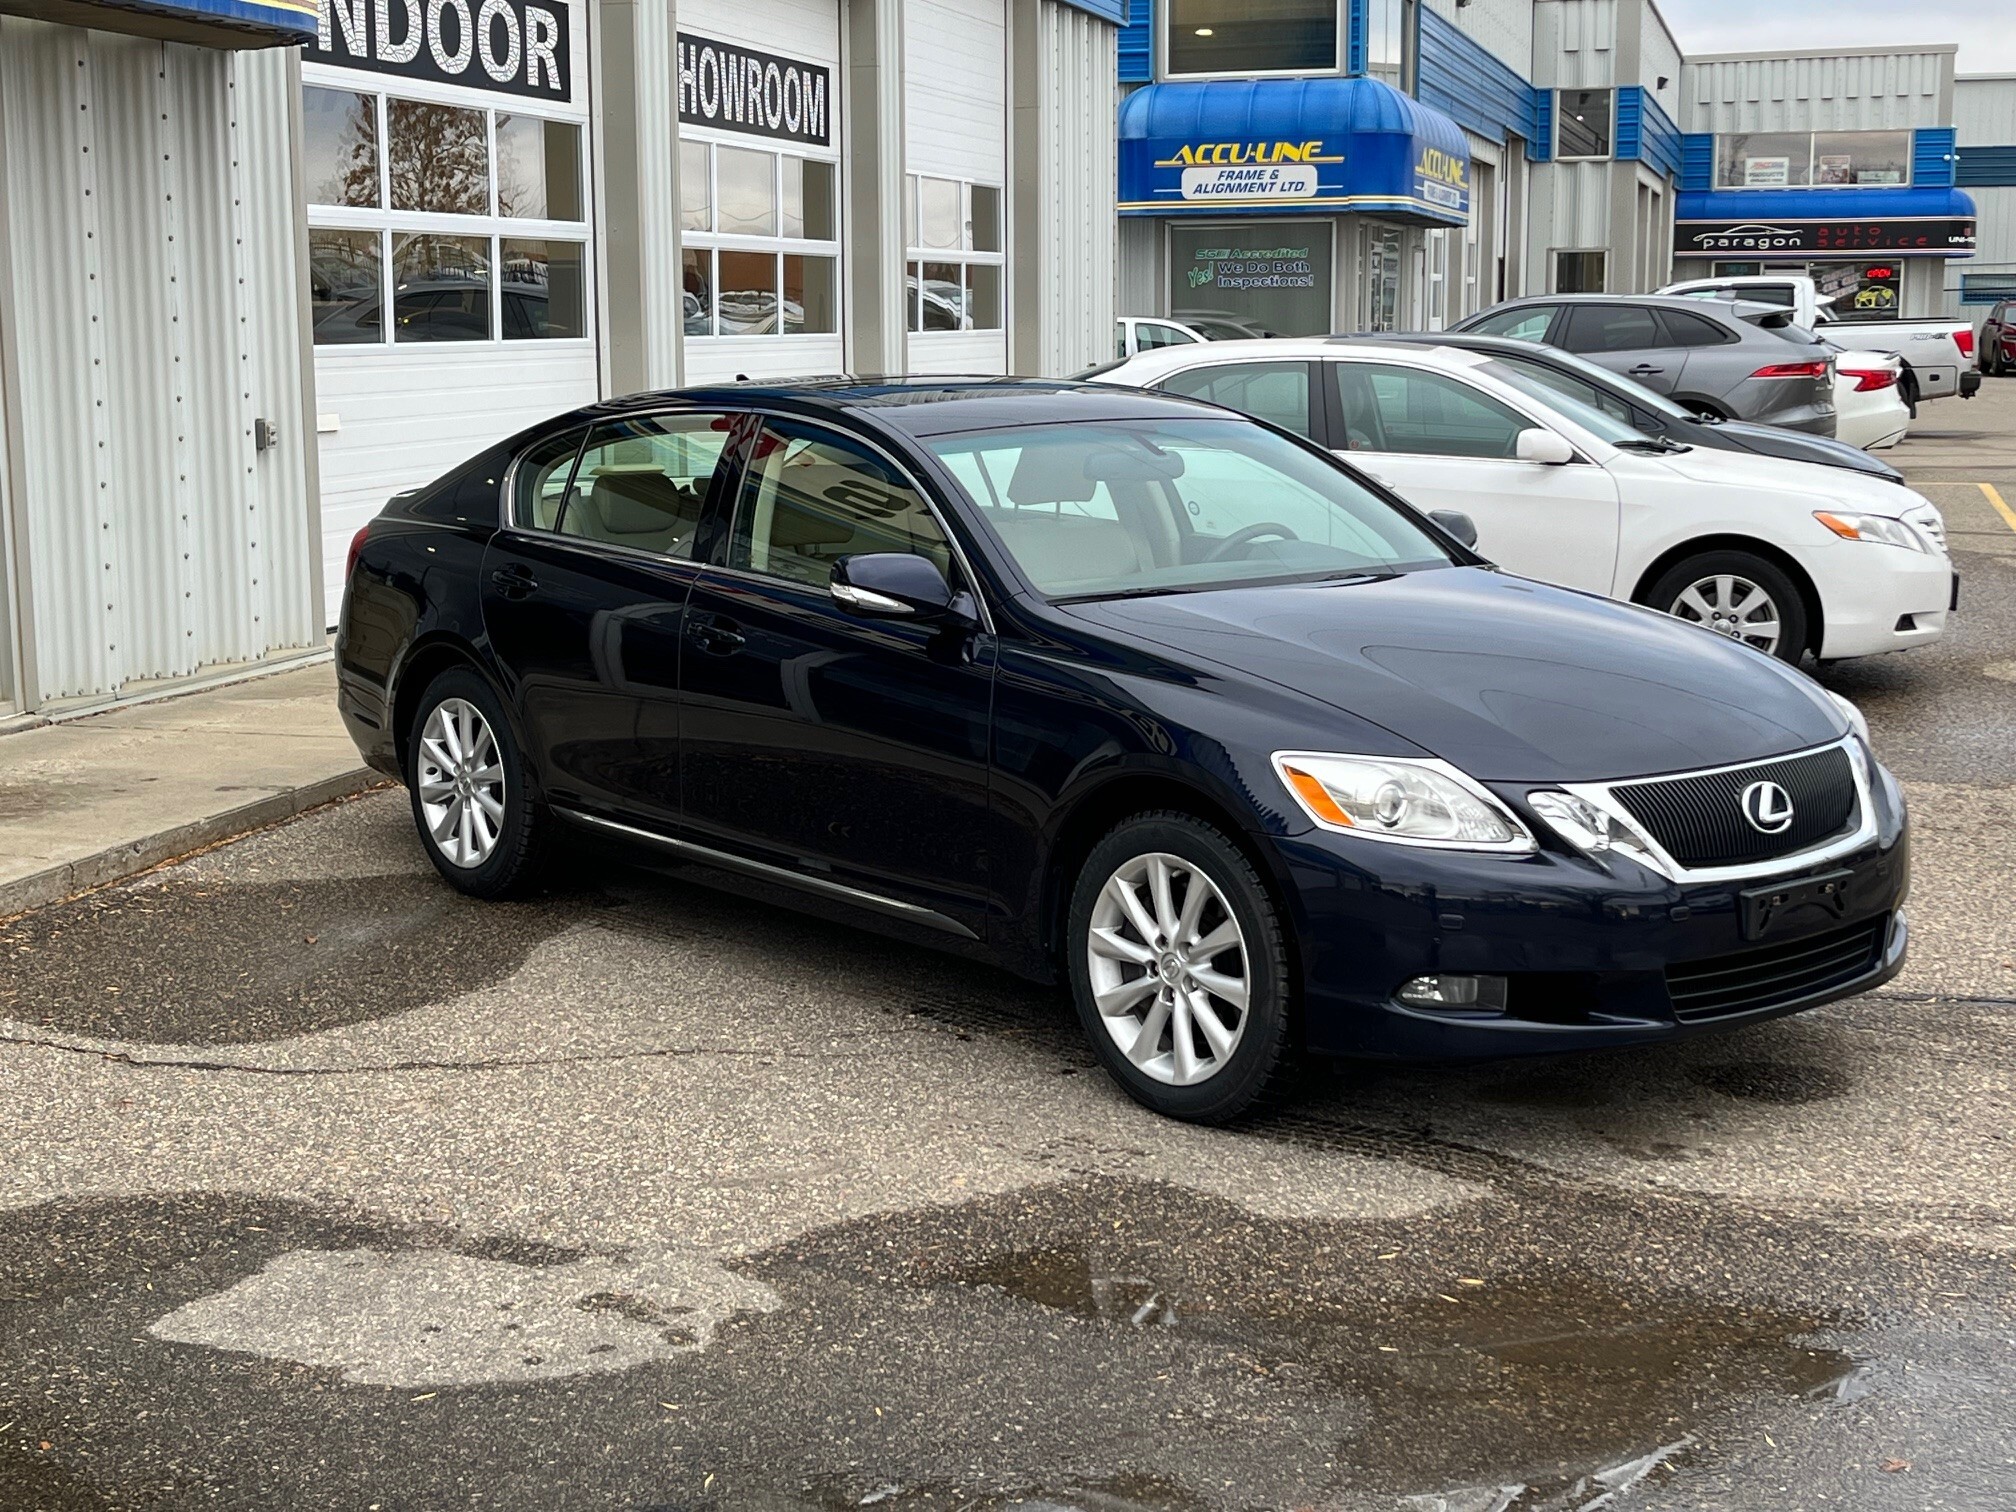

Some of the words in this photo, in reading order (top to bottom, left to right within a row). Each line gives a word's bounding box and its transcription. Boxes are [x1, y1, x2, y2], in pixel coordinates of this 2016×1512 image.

[302, 0, 562, 91] NDOOR
[677, 41, 825, 138] HOWROOM
[1160, 141, 1336, 165] ACCU-LINE
[1217, 170, 1266, 182] FRAME
[1269, 169, 1280, 181] &
[1193, 182, 1277, 195] ALIGNMENT
[1280, 180, 1307, 193] LTD.
[1817, 226, 1882, 236] auto
[1703, 236, 1802, 250] paragon
[1816, 235, 1928, 248] service
[1230, 247, 1309, 260] Accredited
[1217, 262, 1244, 273] We
[1246, 261, 1269, 273] Do
[1273, 261, 1311, 273] Both
[1865, 267, 1893, 279] OPEN
[1188, 261, 1214, 288] Yes!
[1217, 275, 1315, 290] Inspections!
